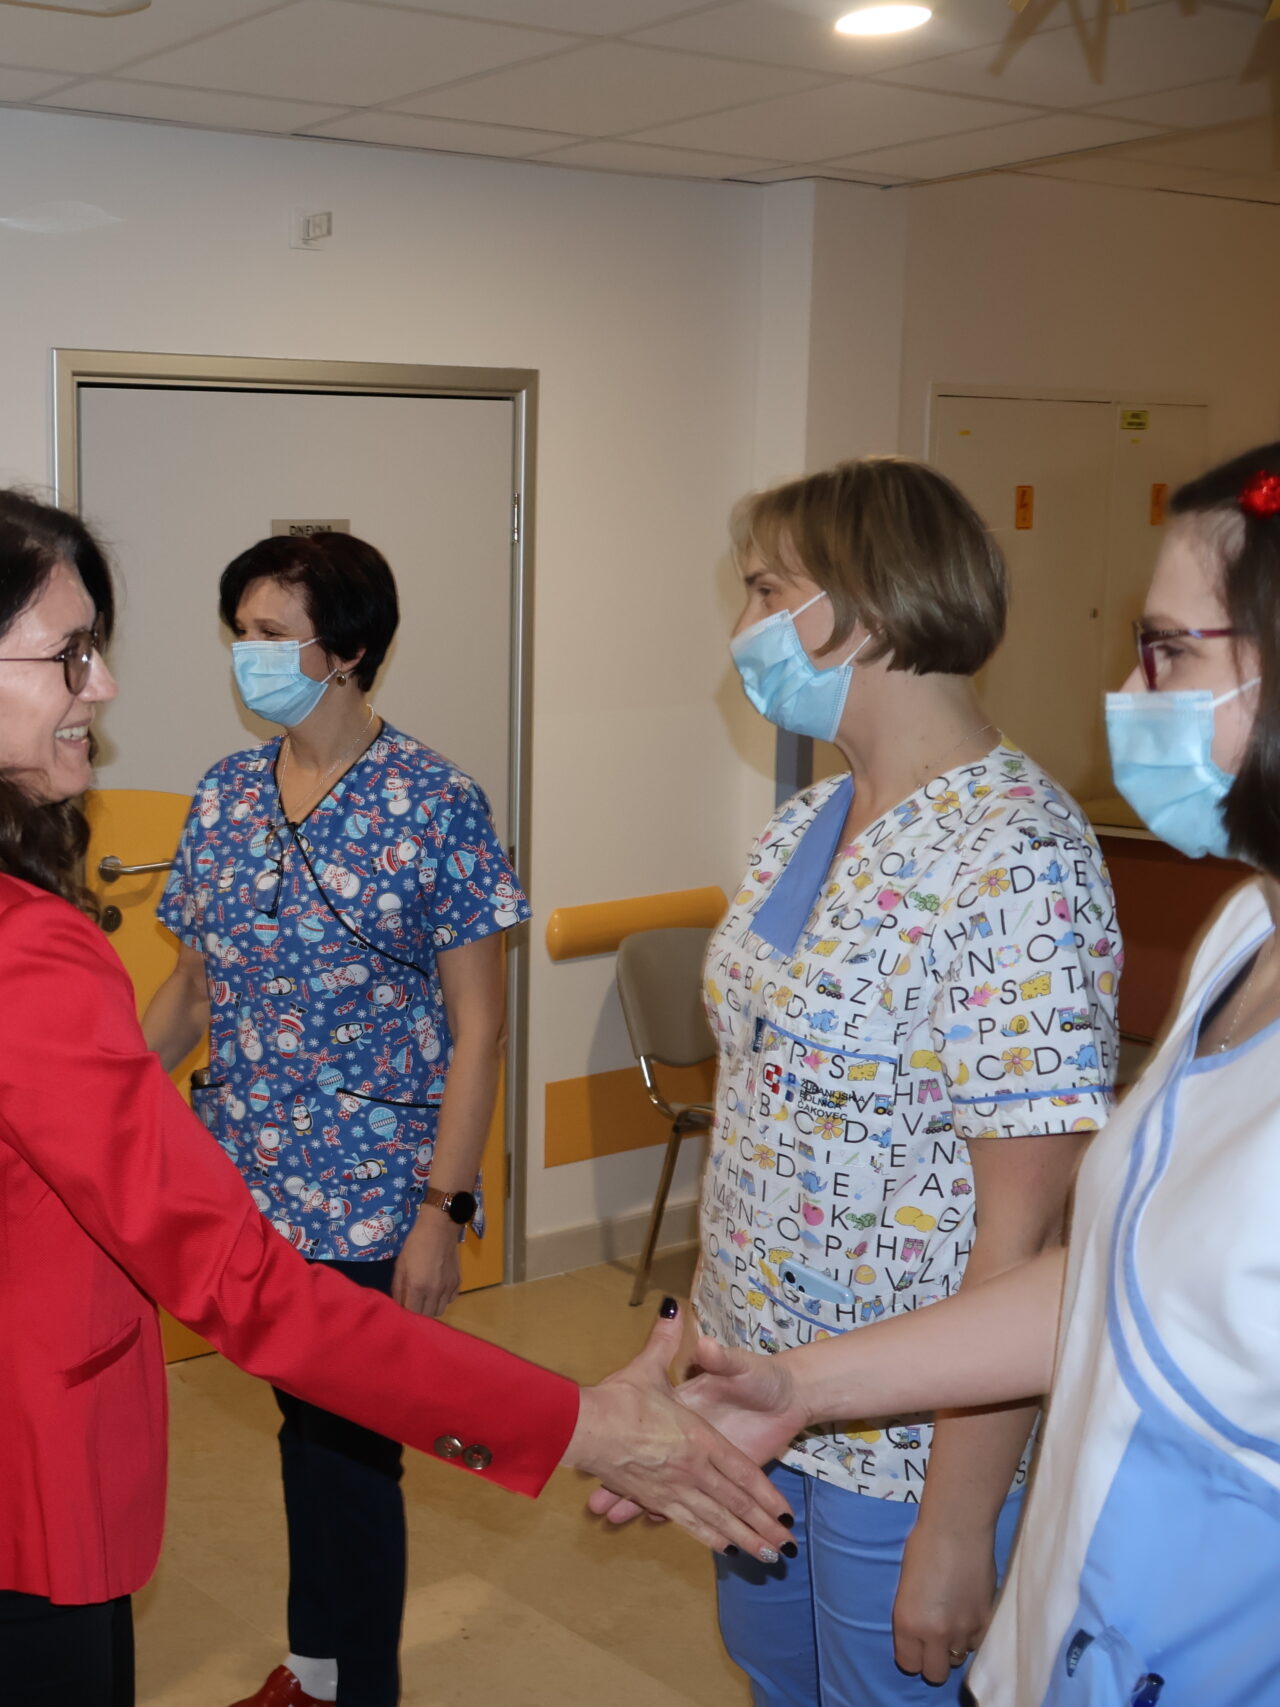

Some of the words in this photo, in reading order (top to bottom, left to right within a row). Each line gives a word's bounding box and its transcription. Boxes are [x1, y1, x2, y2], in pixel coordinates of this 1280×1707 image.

[866, 819, 893, 848] N
[848, 857, 870, 877] S
[971, 828, 995, 852] E
[1010, 865, 1036, 894] D
[1073, 860, 1087, 887] E
[876, 914, 898, 937] P
[944, 922, 967, 950] H
[1000, 909, 1006, 935] I
[1036, 897, 1052, 926] J
[1074, 896, 1091, 924] K
[717, 952, 732, 976] A
[744, 966, 754, 990] B
[841, 942, 859, 964] T
[878, 949, 901, 976] U
[969, 947, 995, 977] N
[1027, 934, 1058, 963] O
[726, 988, 741, 1012] G
[805, 963, 824, 988] V
[850, 977, 873, 1005] Z
[904, 987, 921, 1011] E
[949, 986, 970, 1013] R
[1000, 979, 1017, 1005] S
[1061, 966, 1077, 994] T
[978, 1018, 996, 1045] P
[1030, 1007, 1056, 1036] V
[829, 1055, 846, 1079] S
[898, 1054, 910, 1077] L
[976, 1055, 1006, 1081] C
[1034, 1047, 1062, 1076] D
[894, 1082, 913, 1106] H
[760, 1093, 770, 1117] B
[794, 1110, 814, 1135] C
[844, 1120, 869, 1143] D
[902, 1112, 923, 1136] V
[740, 1136, 753, 1161] C
[776, 1153, 796, 1178] D
[833, 1172, 850, 1197] E
[882, 1179, 897, 1201] F
[890, 1144, 907, 1168] E
[932, 1141, 956, 1164] N
[727, 1158, 739, 1186] H
[789, 1193, 801, 1214] J
[831, 1204, 851, 1230] K
[880, 1206, 894, 1229] L
[919, 1173, 944, 1198] A
[738, 1198, 753, 1226] N
[777, 1216, 801, 1242] O
[825, 1234, 842, 1257] P
[937, 1207, 961, 1233] G
[753, 1237, 766, 1260] S
[876, 1234, 897, 1261] H
[735, 1256, 746, 1277] P
[836, 1303, 856, 1324] H
